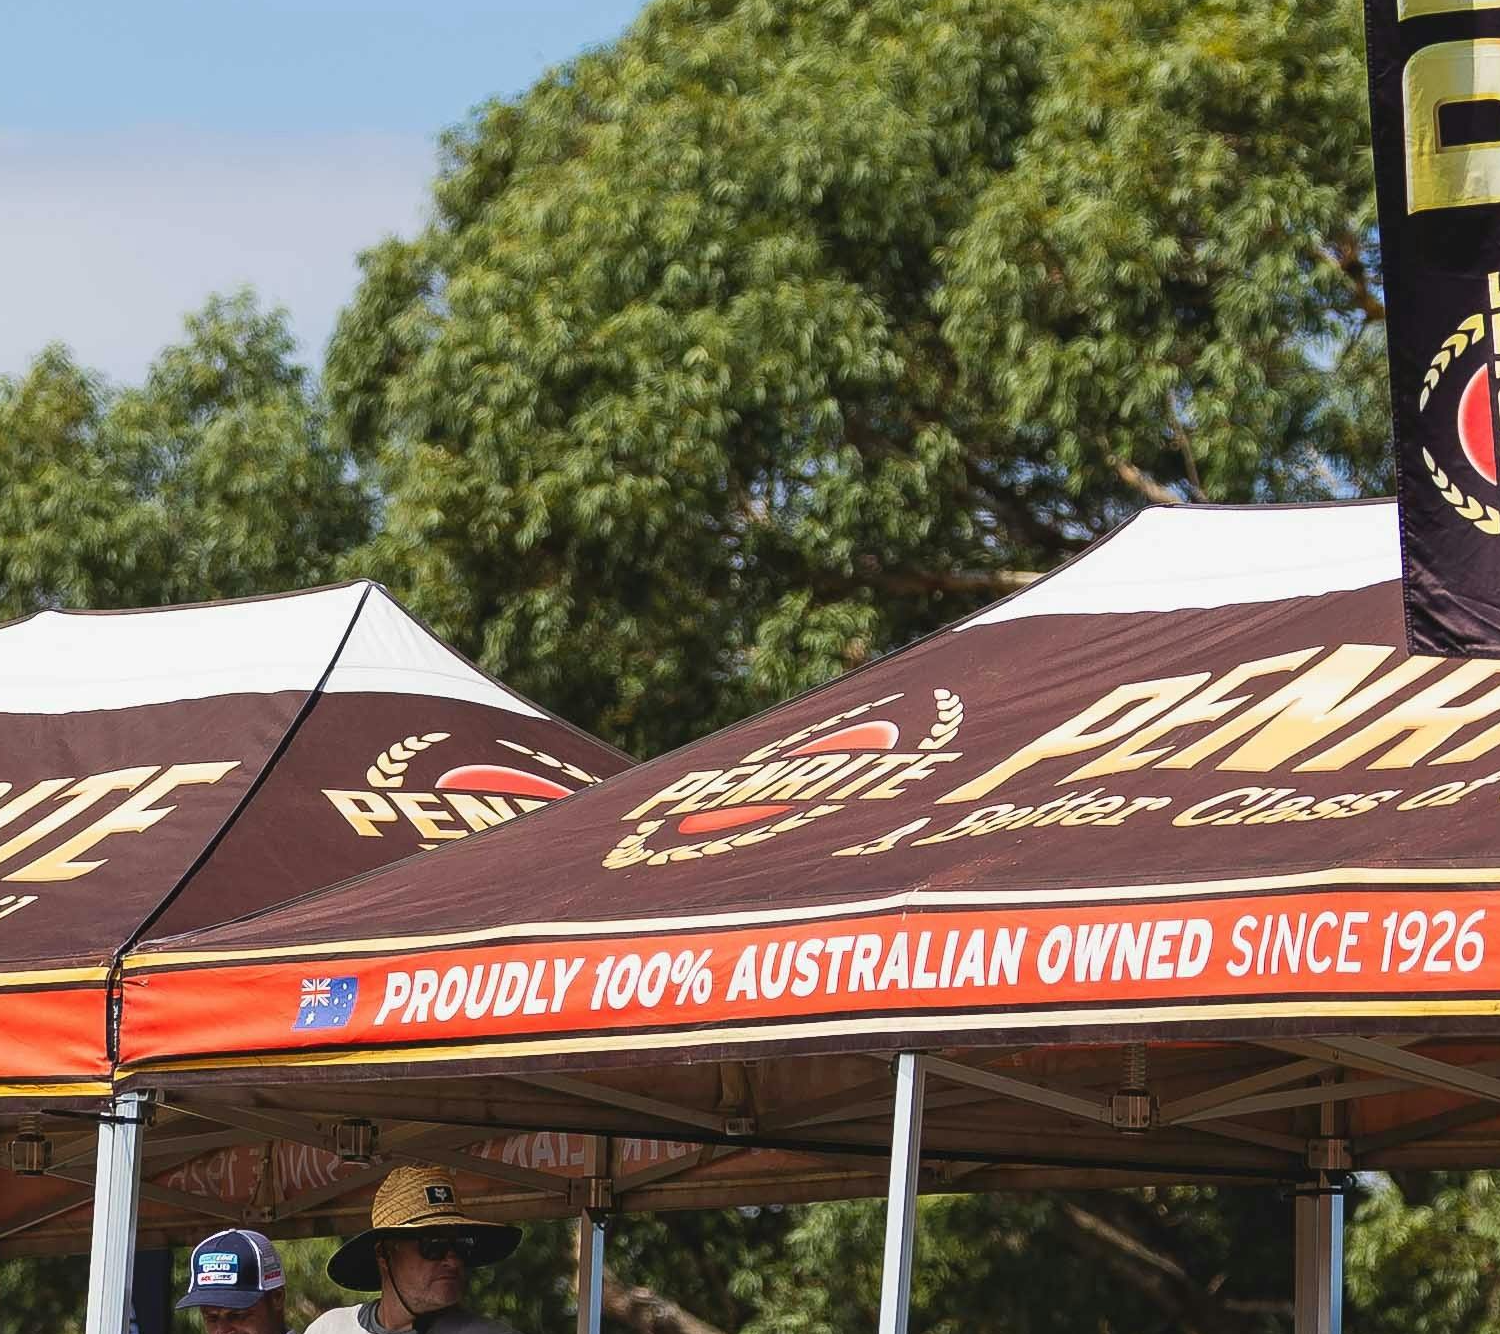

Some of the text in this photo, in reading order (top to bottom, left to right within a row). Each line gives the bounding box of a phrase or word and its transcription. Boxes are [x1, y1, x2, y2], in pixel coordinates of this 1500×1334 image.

[620, 752, 964, 822] PENRITE
[830, 817, 931, 857] A
[910, 786, 1172, 847] Better
[1171, 785, 1402, 830] Class
[372, 907, 1487, 1027] PROUDLY 100% AUSTRALIAN OWNED SINCE 1926
